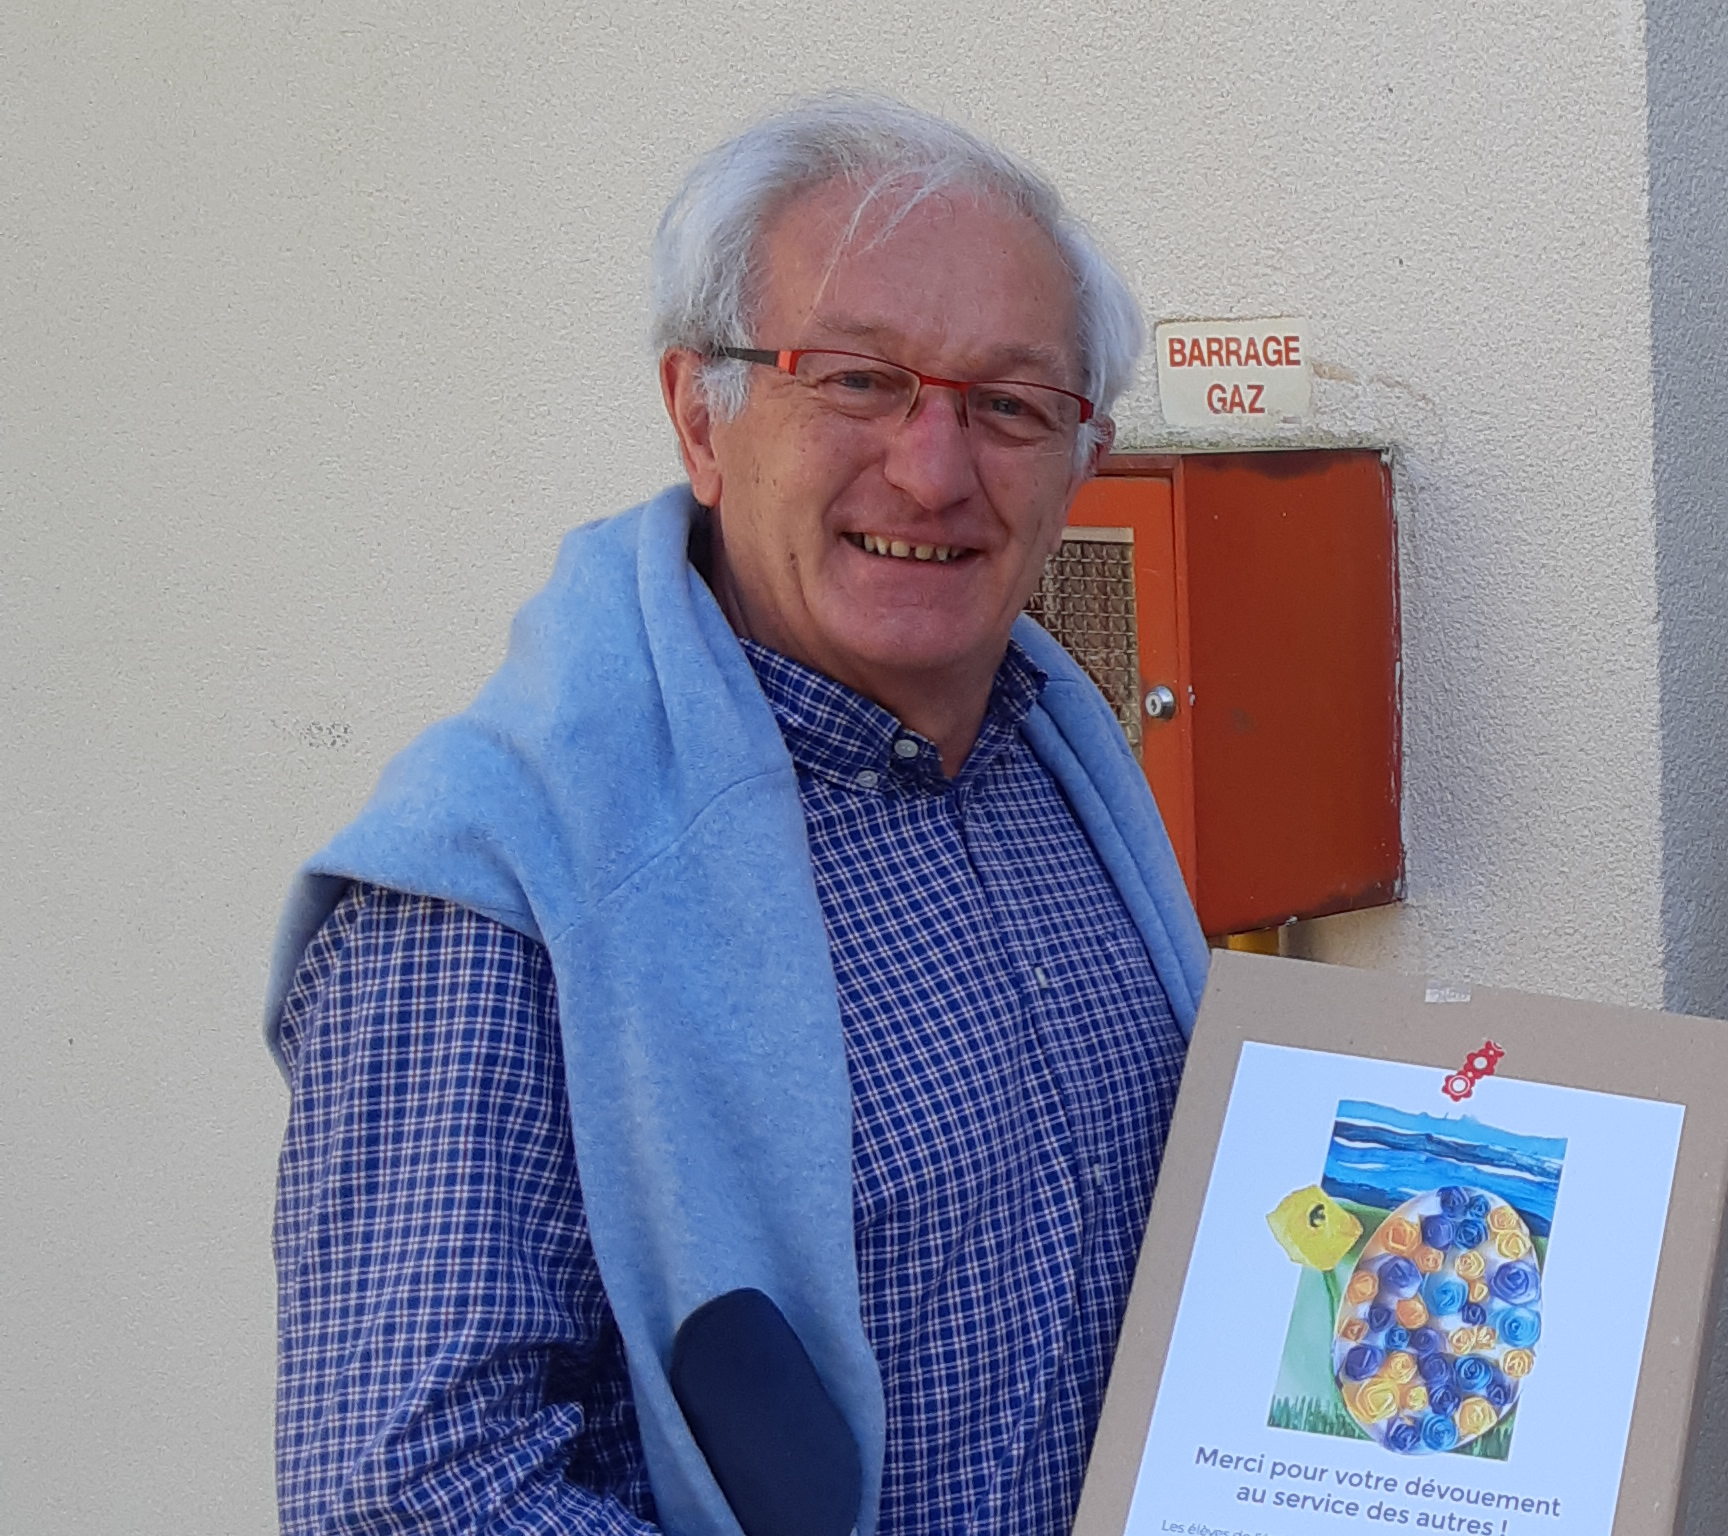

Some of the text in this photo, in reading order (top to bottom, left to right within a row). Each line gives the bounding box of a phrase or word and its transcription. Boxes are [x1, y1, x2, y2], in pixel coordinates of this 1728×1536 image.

[1168, 335, 1301, 367] BARRAGE
[1207, 383, 1265, 415] GAZ
[1195, 1446, 1562, 1518] Merci pour votre dévouement
[1236, 1483, 1266, 1504] au
[1273, 1490, 1360, 1517] service
[1367, 1500, 1418, 1525] des
[1416, 1510, 1494, 1536] autres
[1161, 1519, 1185, 1534] Les
